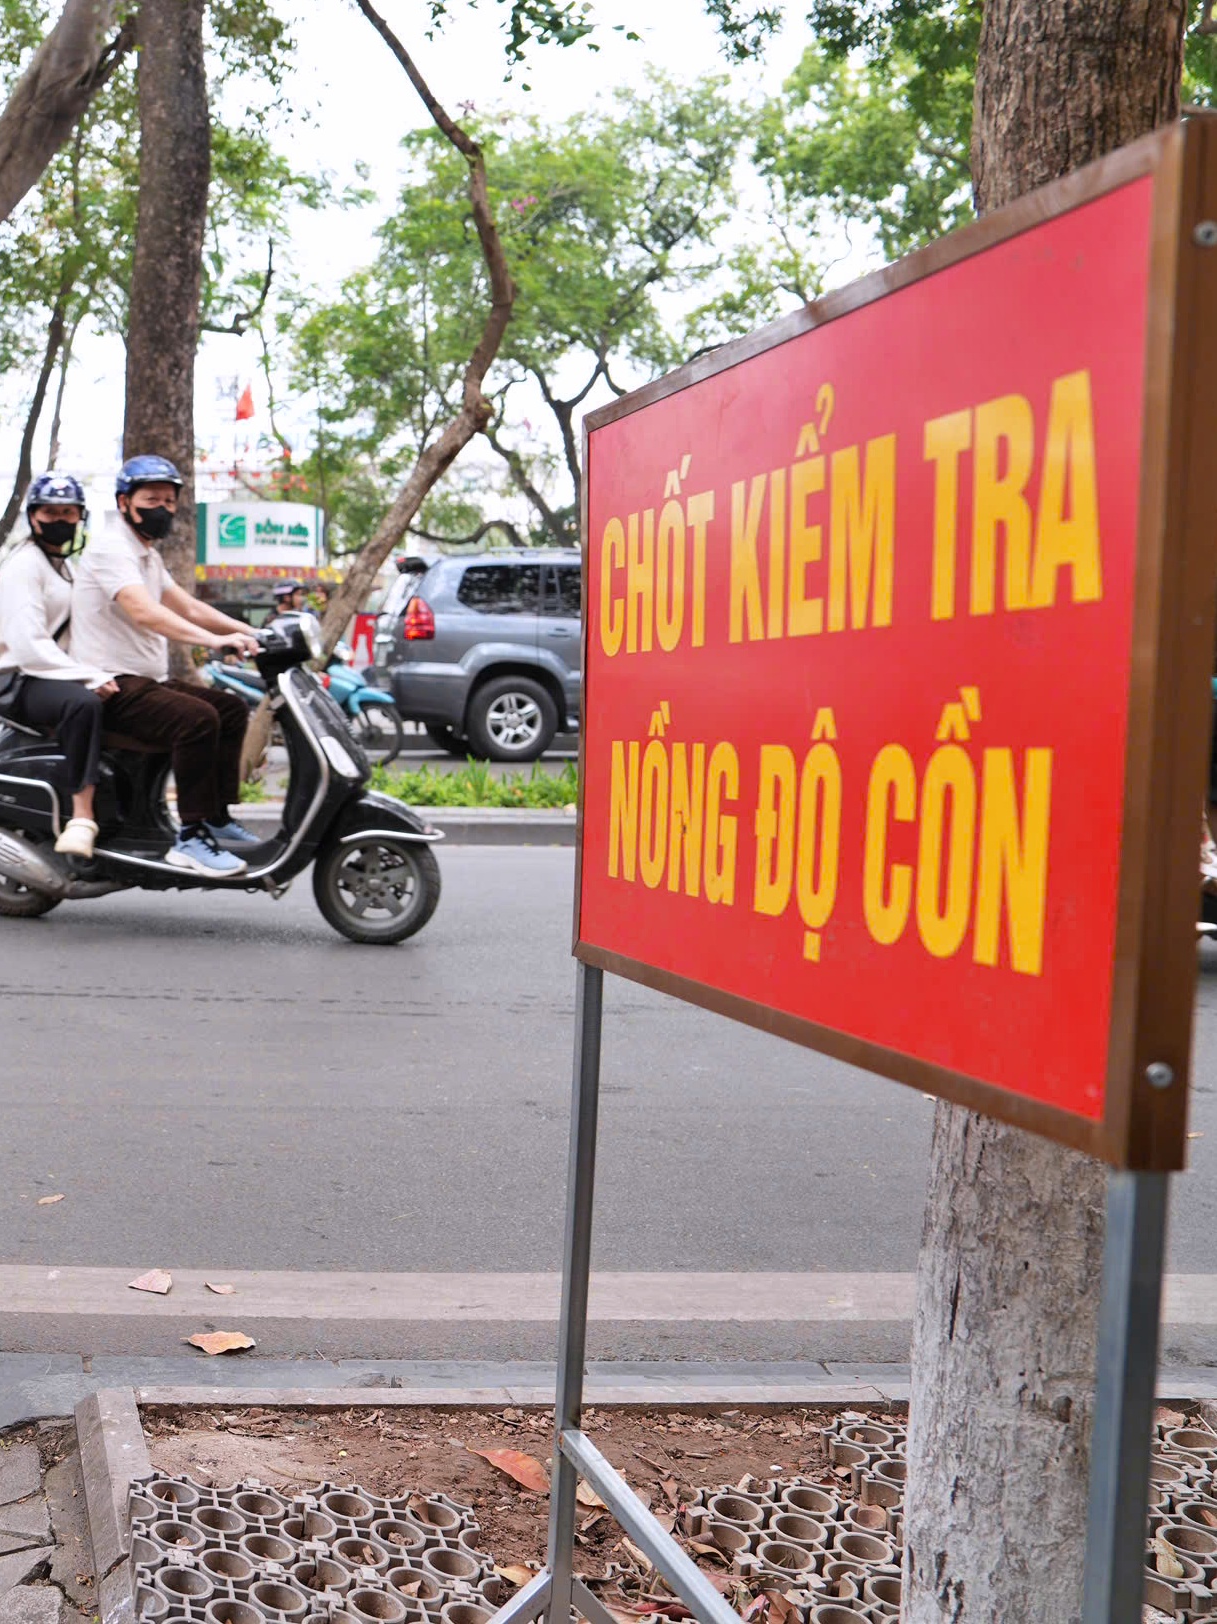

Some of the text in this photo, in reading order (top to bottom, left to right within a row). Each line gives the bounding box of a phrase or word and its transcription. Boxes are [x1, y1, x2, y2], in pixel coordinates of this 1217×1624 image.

[600, 369, 1103, 657] CHỐT KIỂM TRA
[607, 686, 1053, 977] NỒNG ĐỘ CỒN
